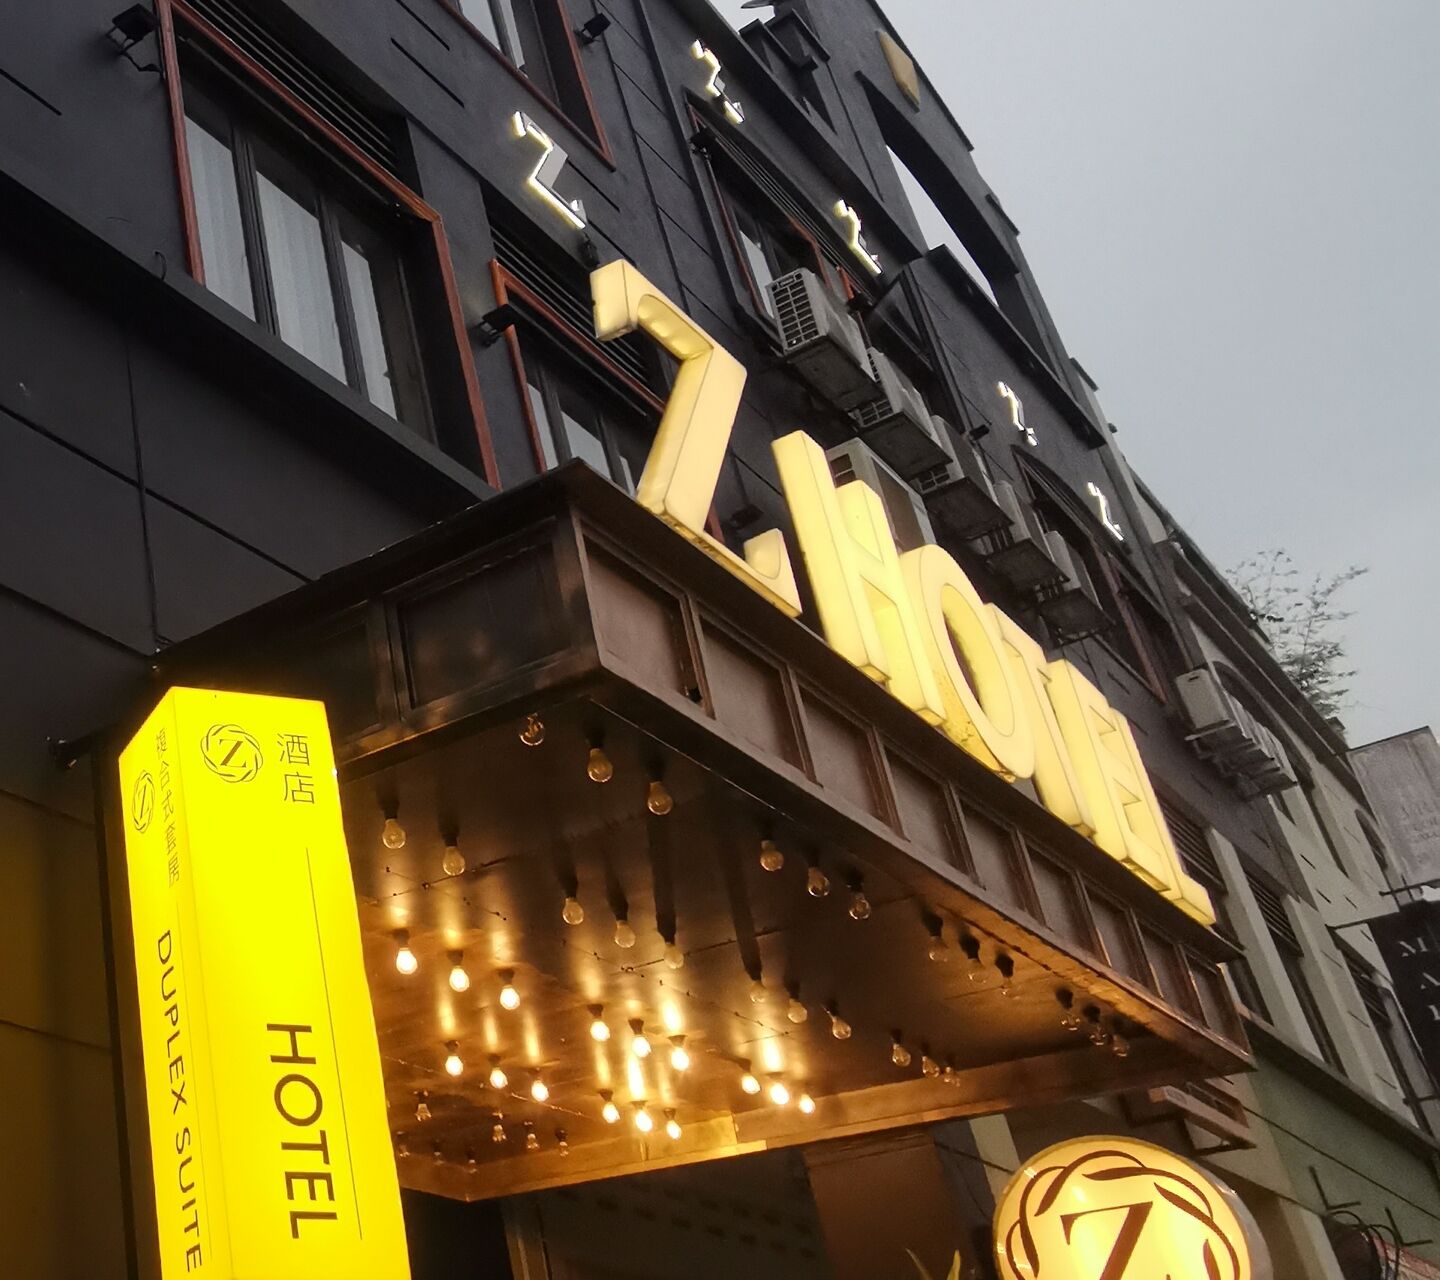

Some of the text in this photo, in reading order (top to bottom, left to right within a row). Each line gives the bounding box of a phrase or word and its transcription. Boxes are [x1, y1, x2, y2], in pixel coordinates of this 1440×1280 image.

[589, 258, 1217, 927] Z HOTEL
[275, 732, 316, 805] 酒店
[156, 929, 204, 1274] DUPLEX SUITE
[266, 1023, 337, 1240] HOTEL
